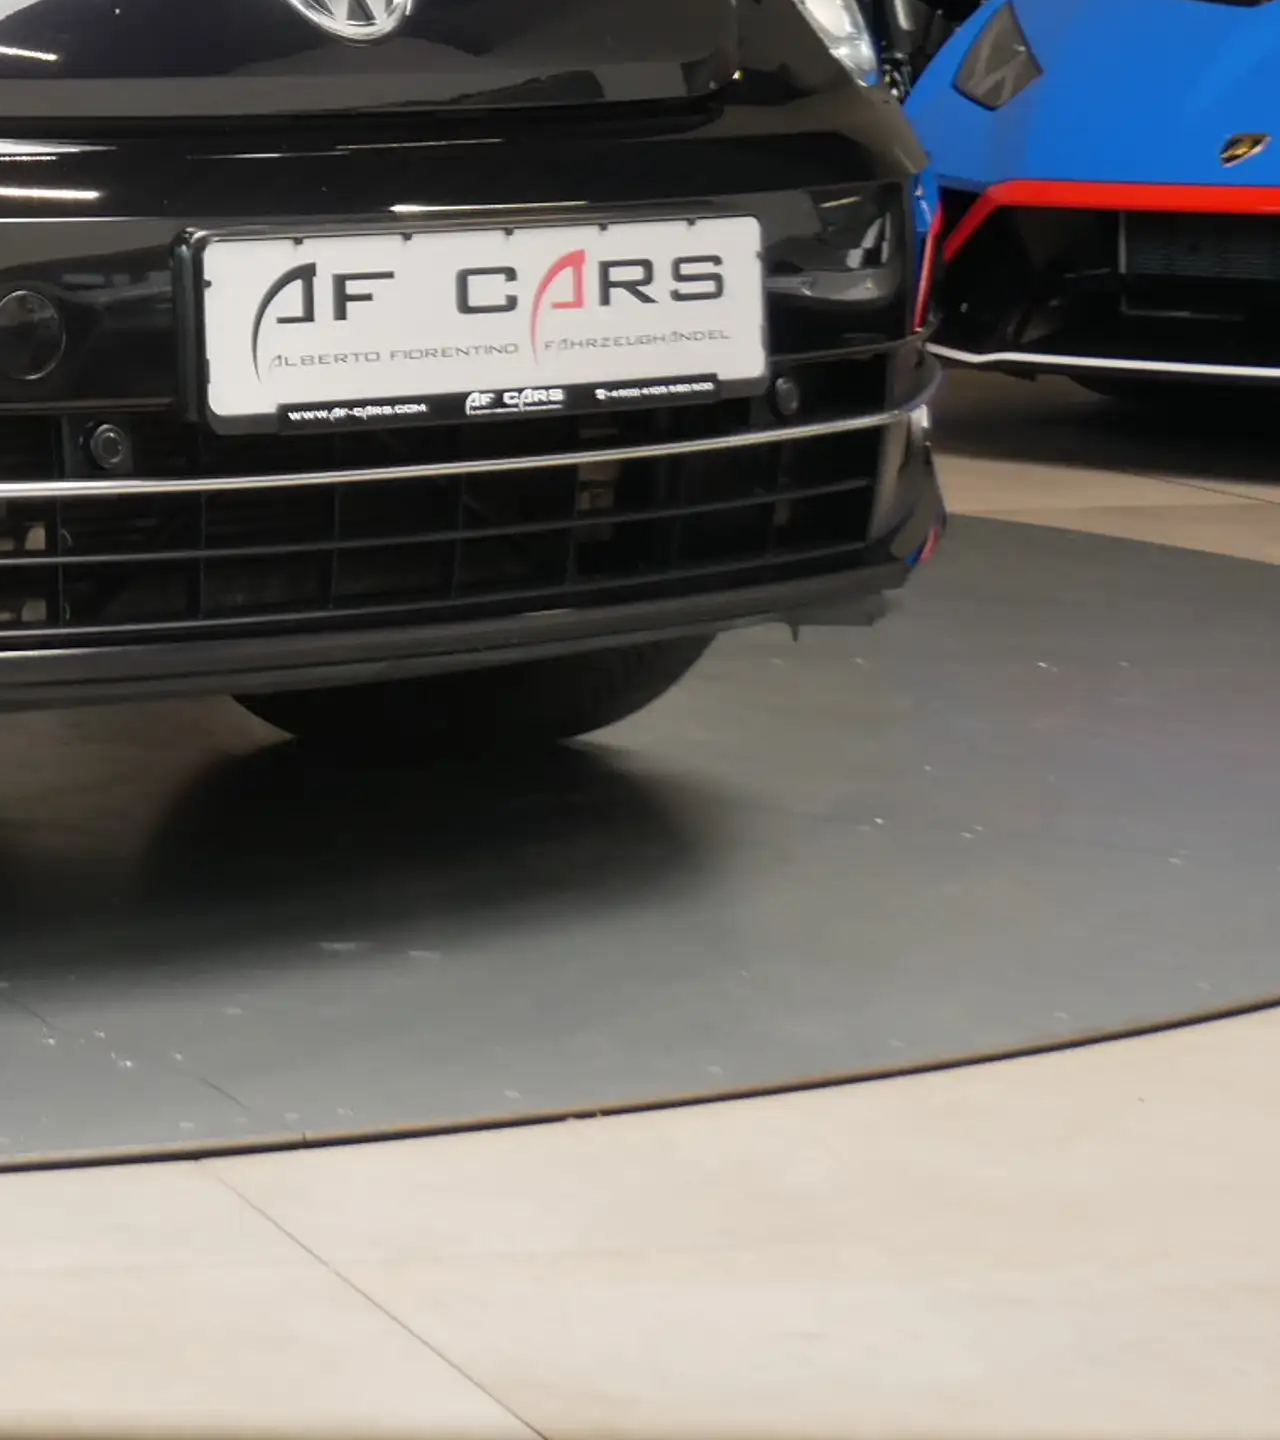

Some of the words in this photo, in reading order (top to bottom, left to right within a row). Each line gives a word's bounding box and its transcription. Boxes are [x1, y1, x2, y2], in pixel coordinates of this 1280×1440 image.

[251, 262, 395, 384] AF
[454, 248, 725, 365] CARS
[544, 329, 732, 352] FAHRZEUGHANDEL
[269, 351, 381, 374] ALBERTO
[390, 342, 519, 362] FIORENTINO
[465, 392, 495, 416] AF
[503, 388, 564, 412] CARS
